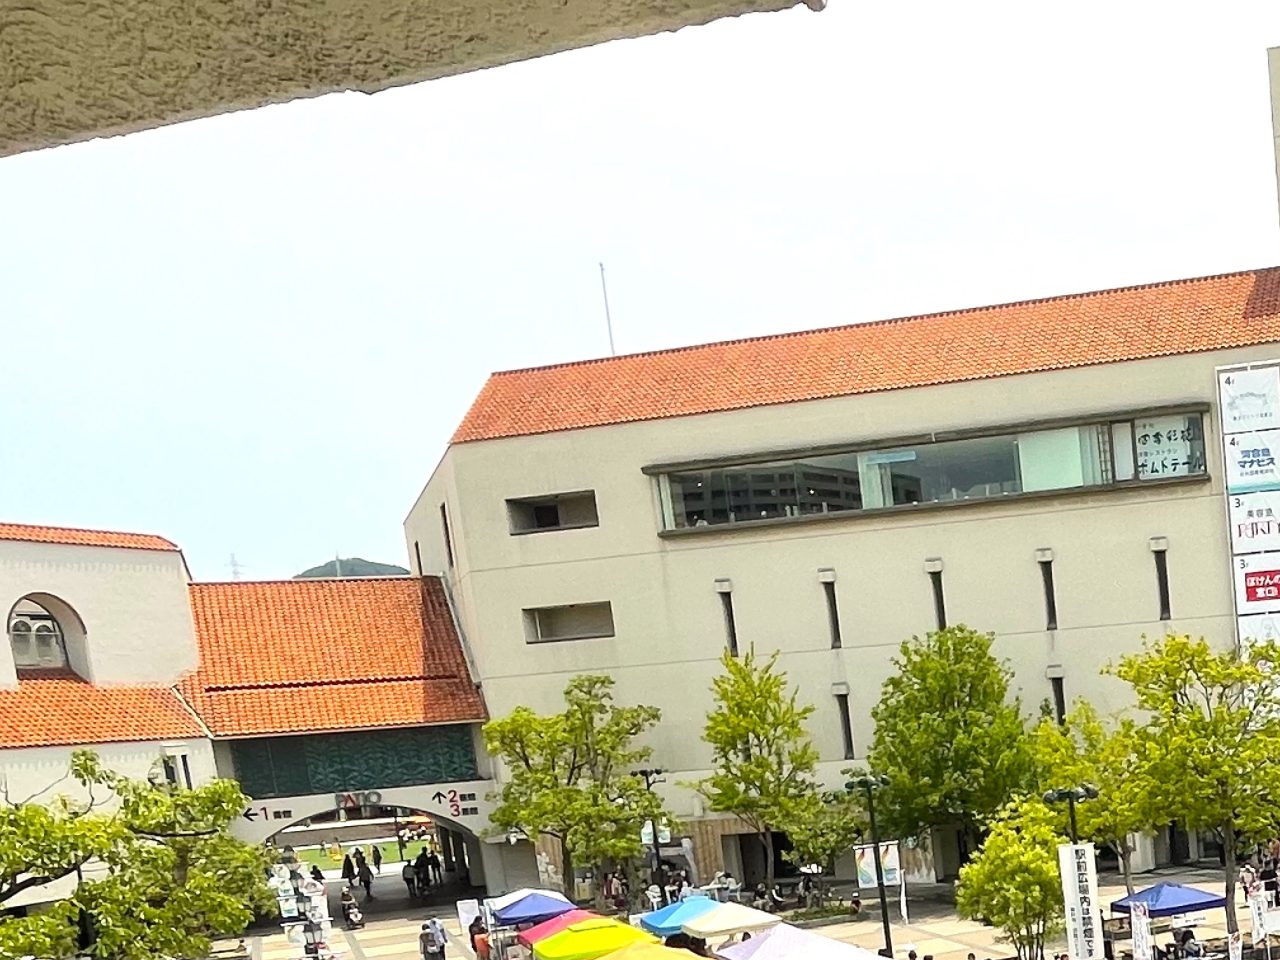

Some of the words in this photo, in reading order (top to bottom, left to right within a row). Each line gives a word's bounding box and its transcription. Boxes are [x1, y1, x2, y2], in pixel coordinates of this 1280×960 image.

[1237, 457, 1276, 469] マナビス
[335, 791, 382, 809] PATIO
